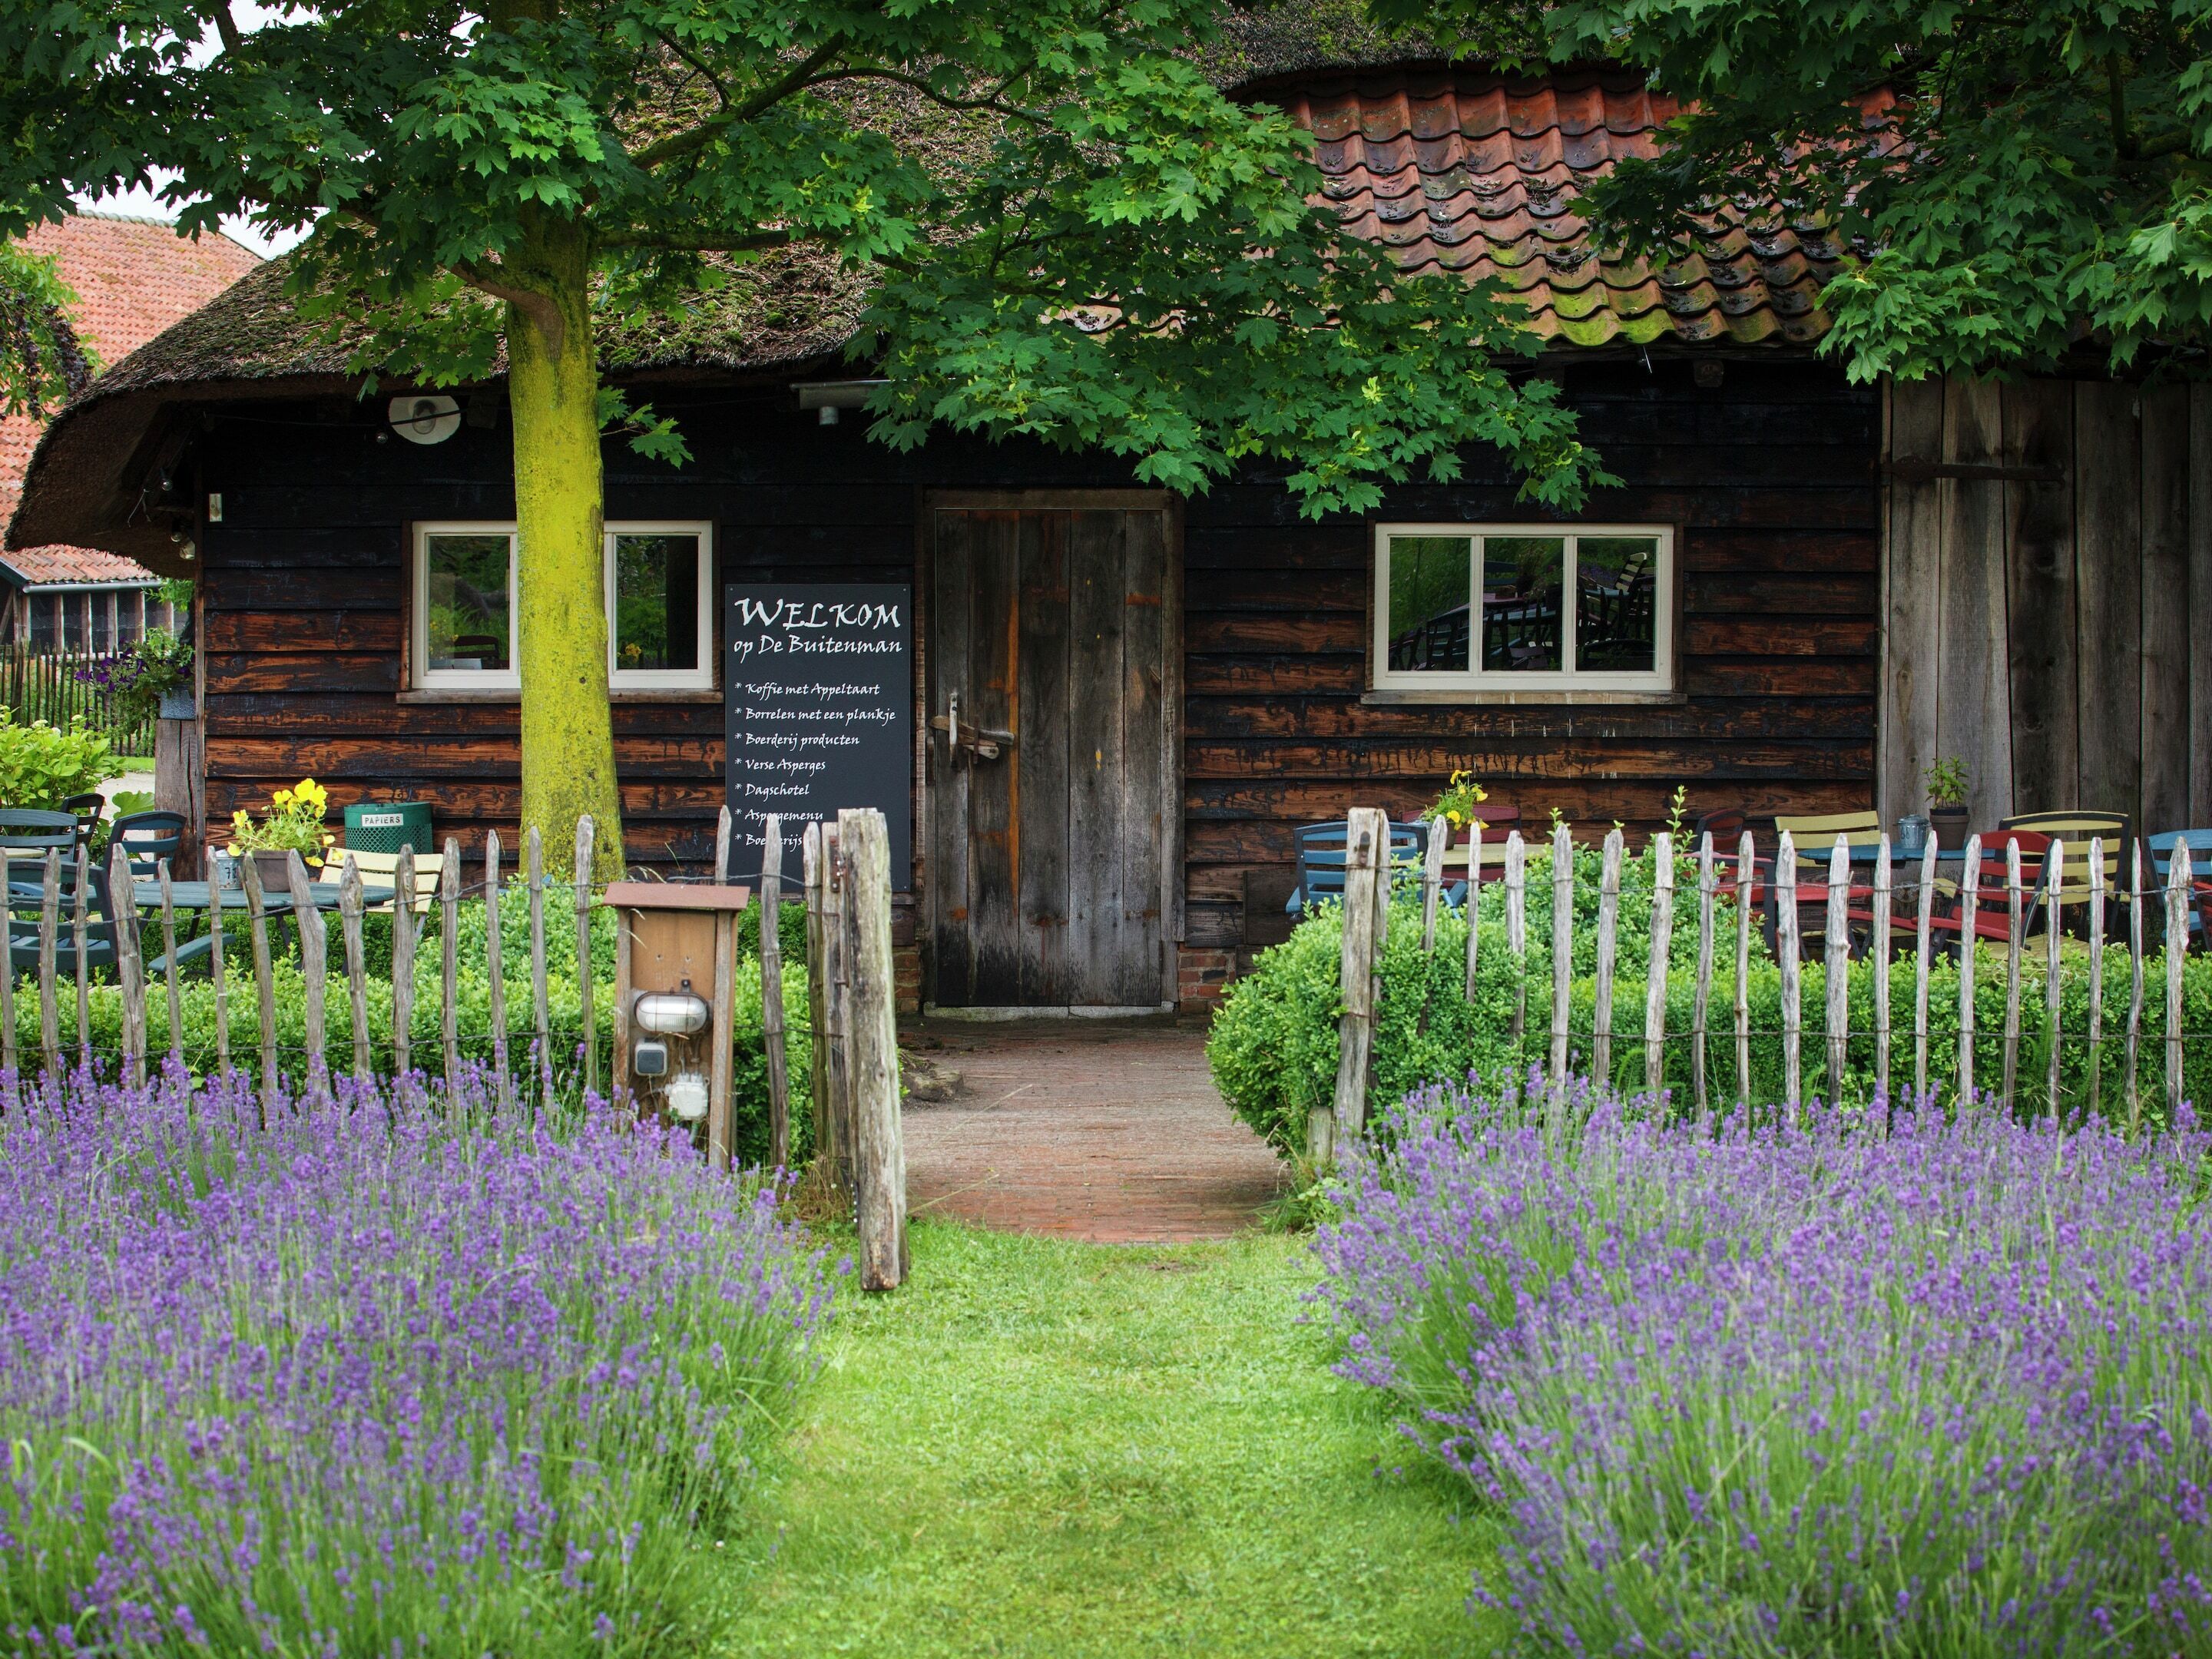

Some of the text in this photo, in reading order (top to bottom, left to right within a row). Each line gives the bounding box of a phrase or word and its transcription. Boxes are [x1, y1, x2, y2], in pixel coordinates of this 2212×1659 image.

[734, 598, 901, 631] WELKOM
[733, 634, 902, 664] op De Buitenman
[745, 682, 880, 700] Koffie met Appeltaart
[745, 707, 896, 727] Borrelen met een plankje
[745, 733, 859, 751] Boerderij producten
[745, 758, 826, 777] Verse Asperges
[745, 783, 810, 802] Dagschotel
[745, 833, 803, 852] Boerijs
